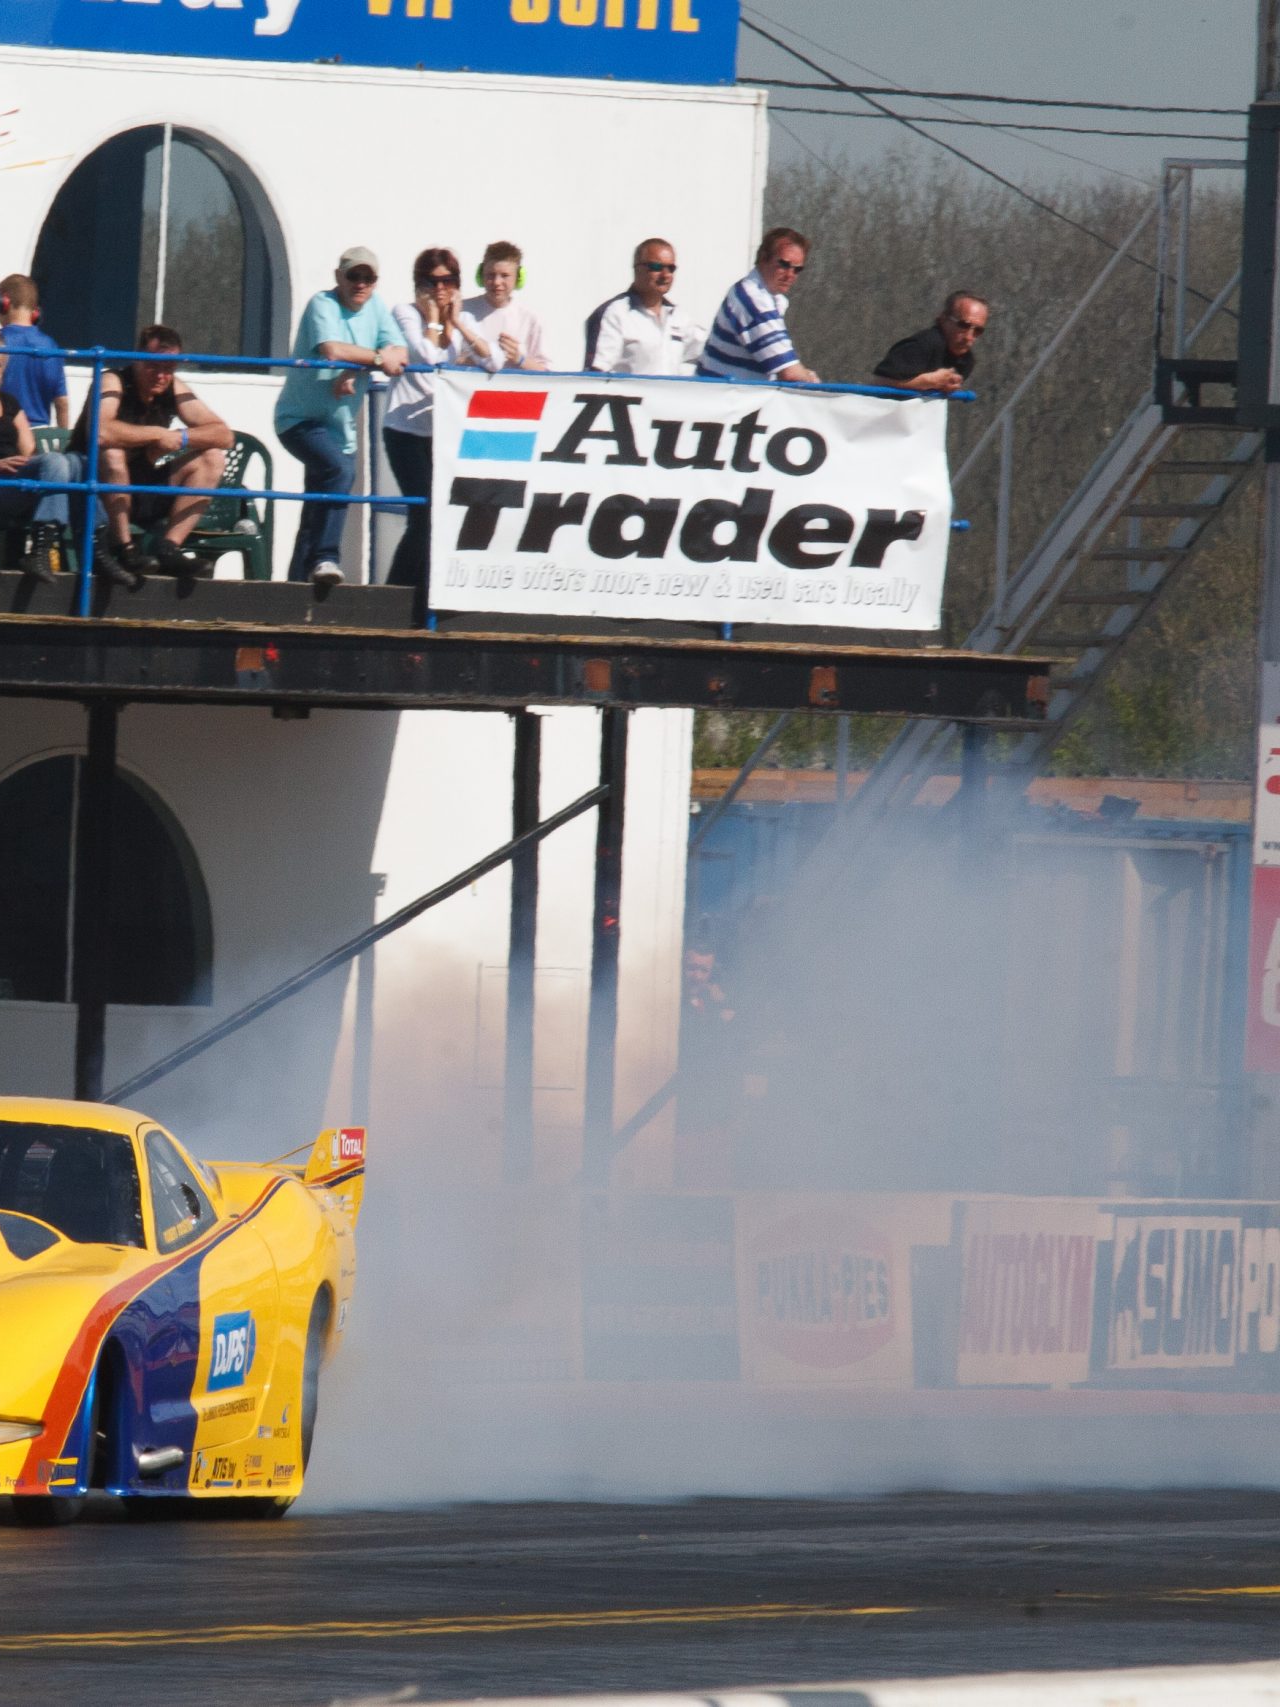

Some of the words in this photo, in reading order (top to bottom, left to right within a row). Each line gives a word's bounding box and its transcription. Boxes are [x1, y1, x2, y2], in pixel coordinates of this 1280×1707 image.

[540, 393, 828, 477] Auto
[449, 476, 927, 570] Trader
[445, 557, 468, 588] No
[475, 563, 514, 590] one
[520, 561, 587, 593] offers
[589, 568, 652, 596] more
[654, 572, 709, 598] new
[714, 569, 731, 599] &
[737, 571, 788, 600] used
[793, 578, 838, 605] cars
[842, 574, 922, 613] locally
[341, 1133, 362, 1156] TOTAL
[213, 1326, 247, 1377] DJPS
